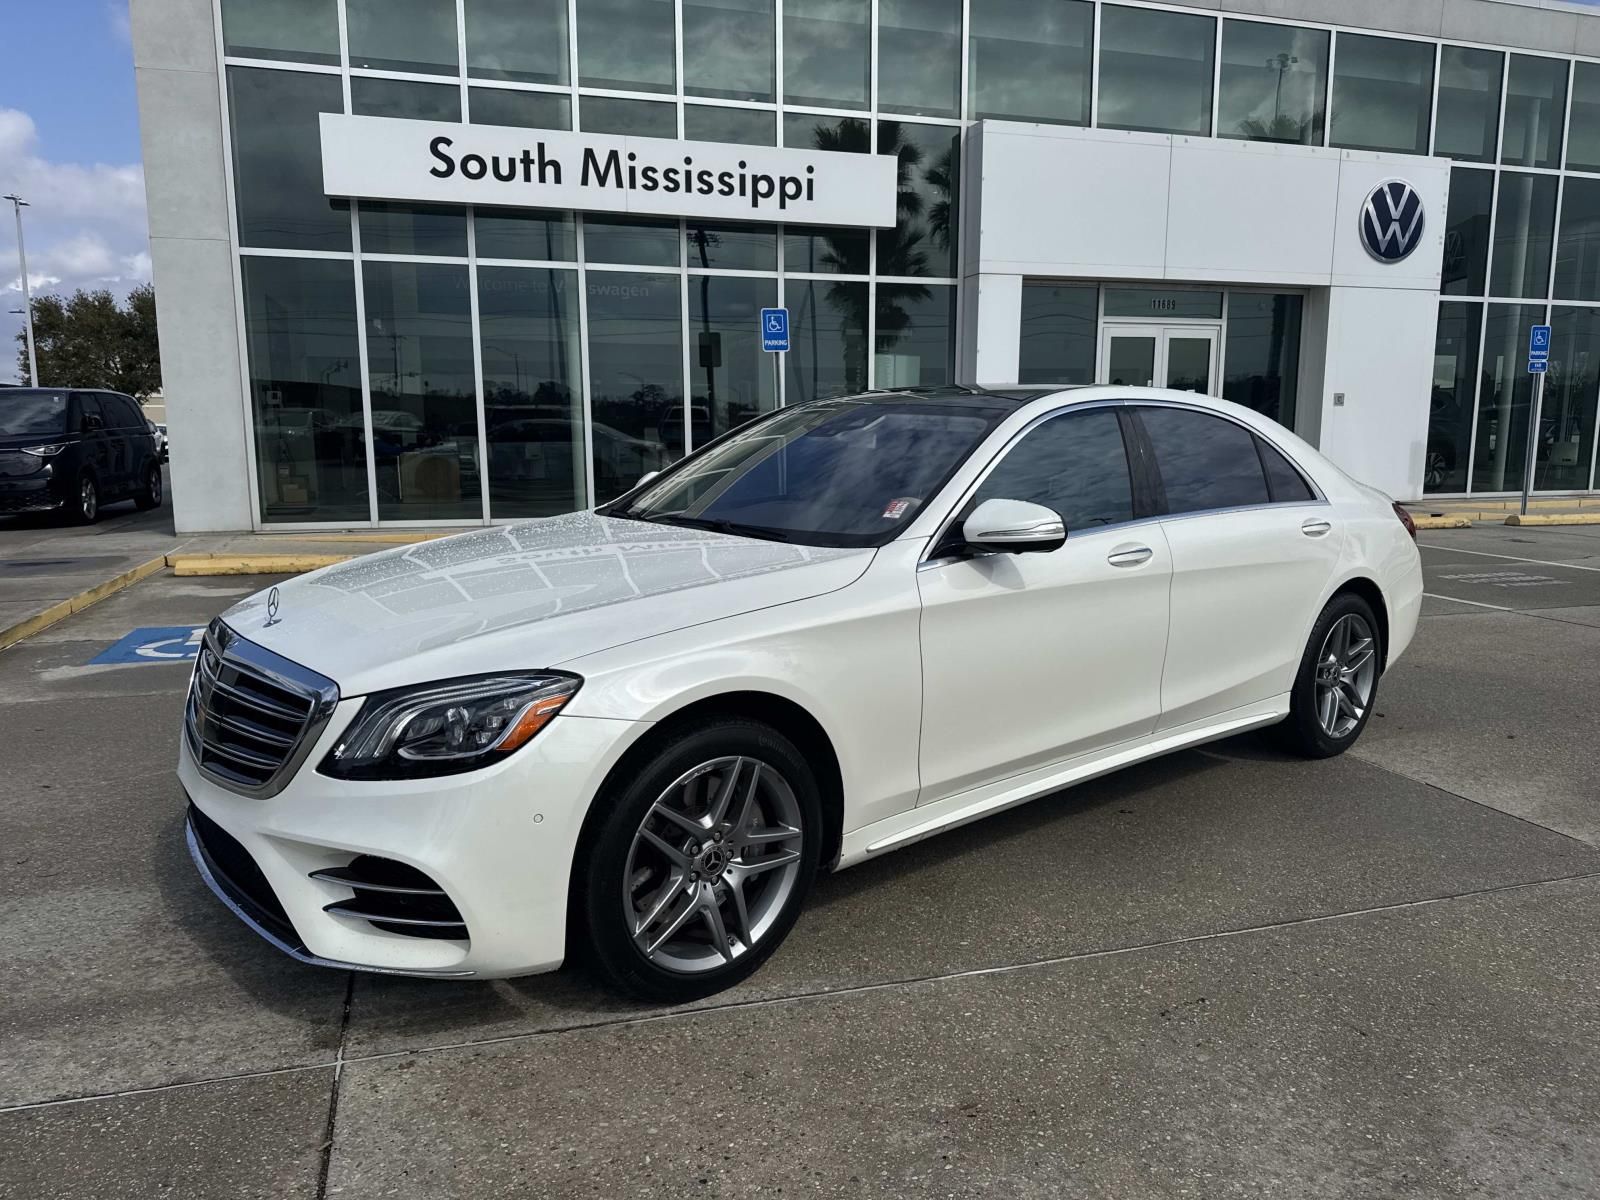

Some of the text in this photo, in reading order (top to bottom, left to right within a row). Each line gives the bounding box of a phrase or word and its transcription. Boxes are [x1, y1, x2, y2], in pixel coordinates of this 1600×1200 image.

[429, 136, 815, 209] South Mississippi
[1362, 181, 1423, 255] VW
